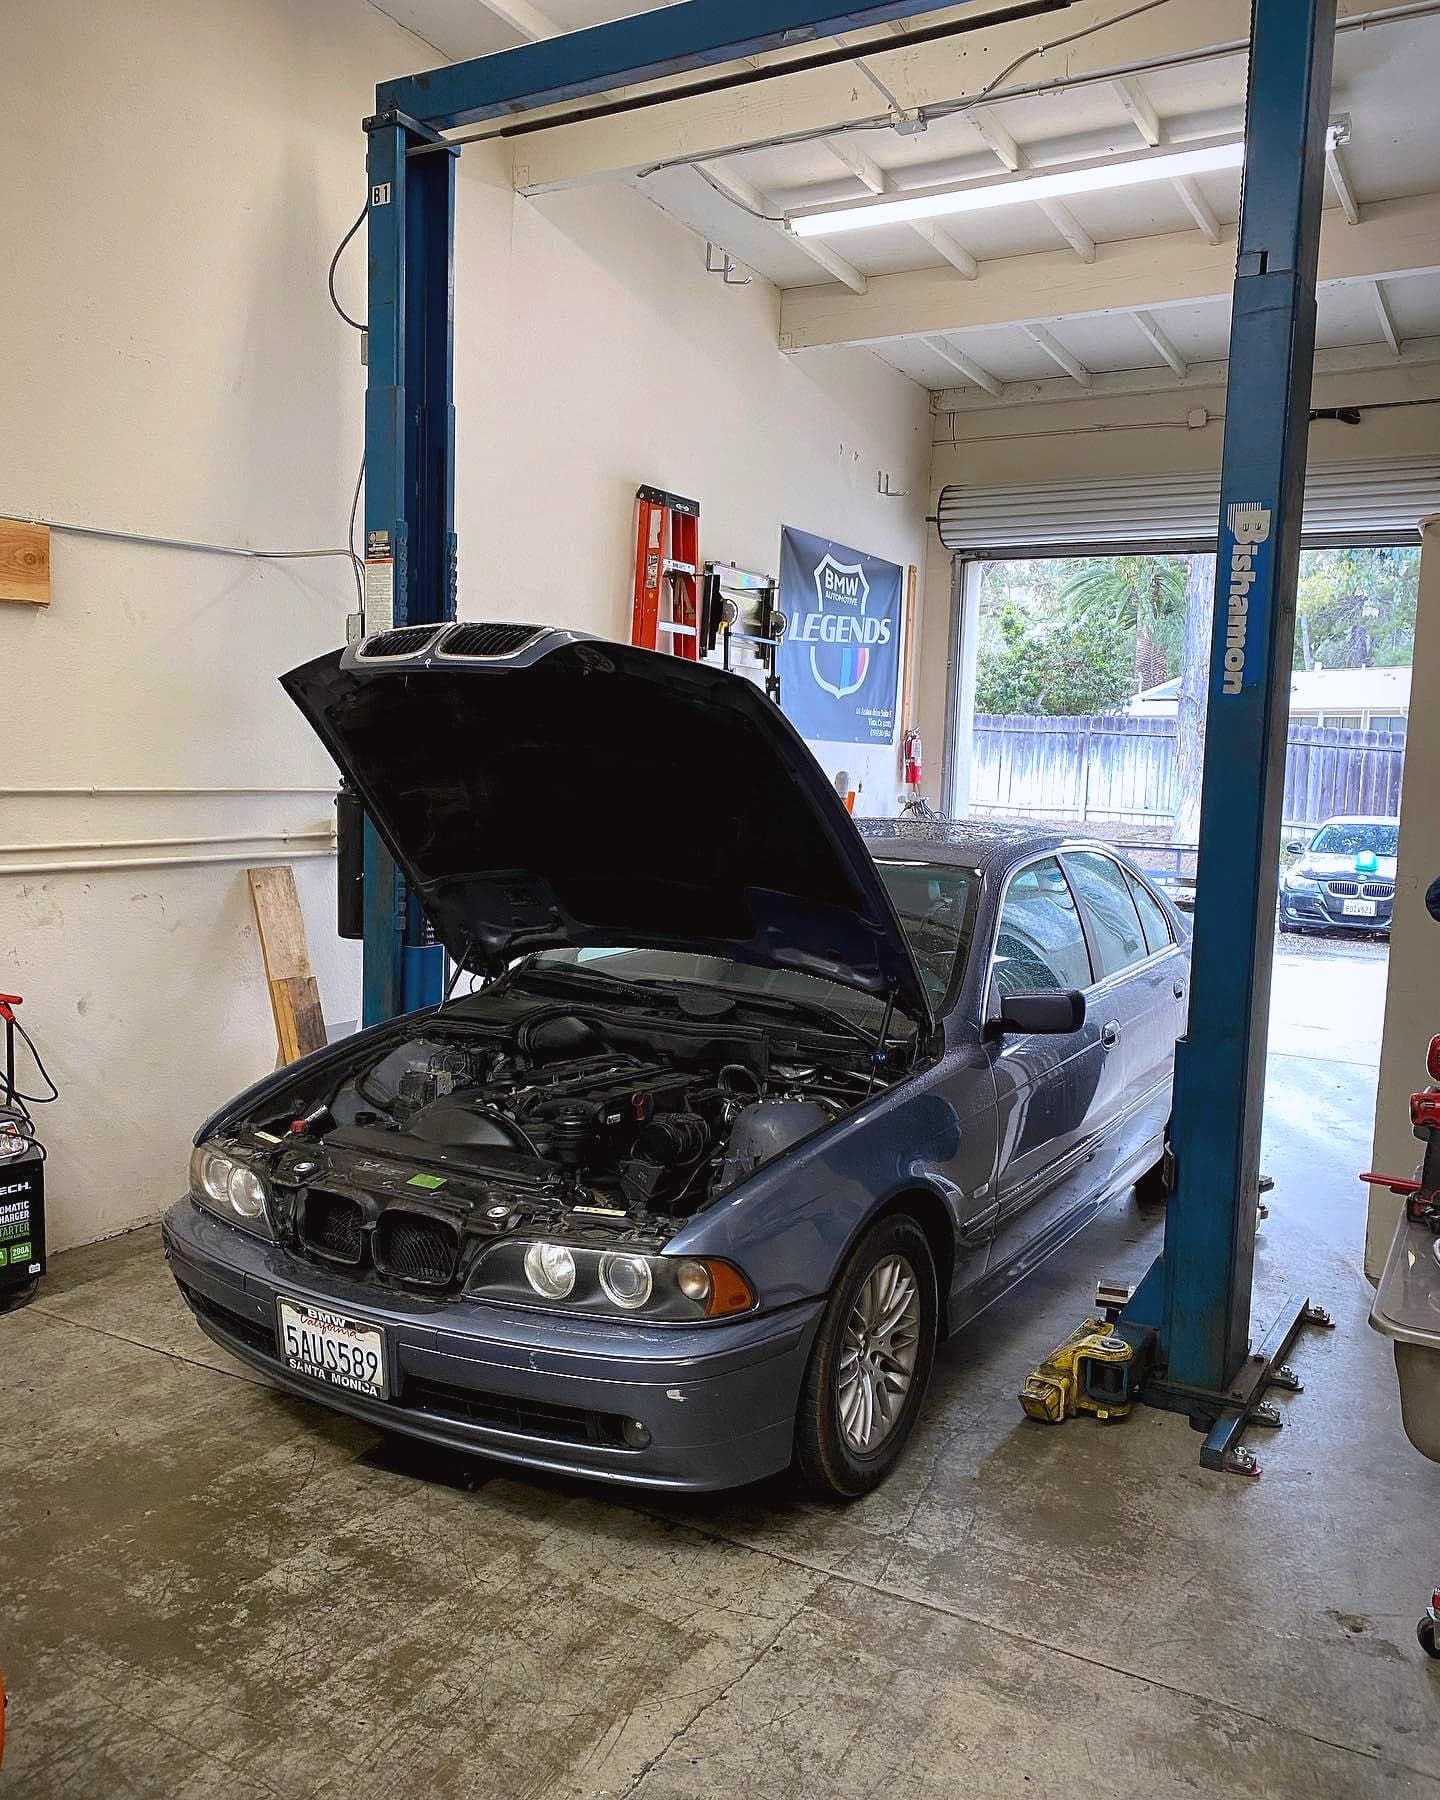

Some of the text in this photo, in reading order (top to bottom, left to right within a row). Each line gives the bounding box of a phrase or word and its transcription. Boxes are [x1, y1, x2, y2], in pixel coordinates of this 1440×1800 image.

[825, 568, 859, 596] BMW
[825, 590, 859, 606] AUTOMOTIVE
[1223, 503, 1271, 694] Bishamon
[788, 612, 890, 644] LEGENDS
[13, 1246, 29, 1256] 200A
[308, 1309, 345, 1327] BMW
[286, 1325, 378, 1382] 5AUS589
[289, 1359, 378, 1397] SANTA MONICA
